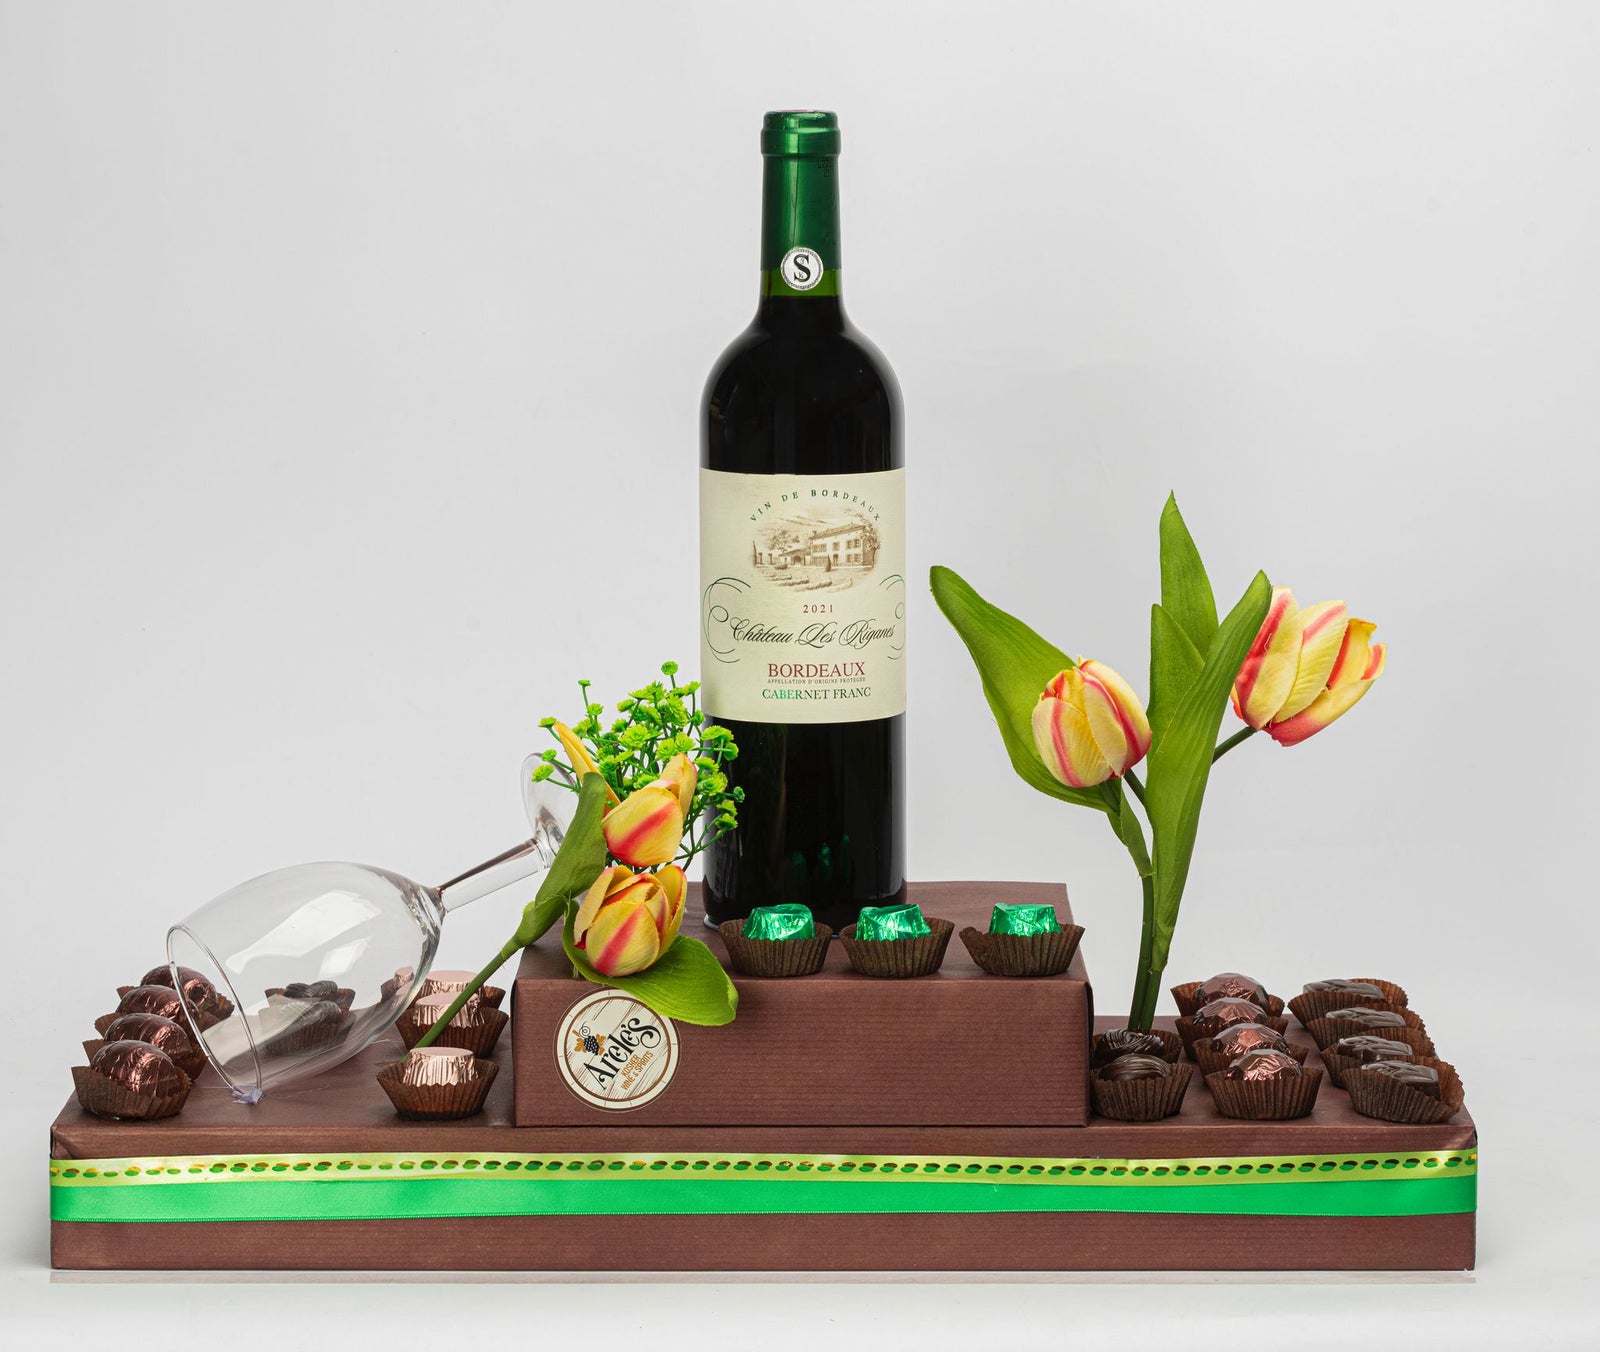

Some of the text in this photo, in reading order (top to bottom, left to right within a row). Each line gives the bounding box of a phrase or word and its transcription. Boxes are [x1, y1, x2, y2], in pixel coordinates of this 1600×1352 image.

[793, 253, 811, 282] S
[750, 489, 880, 521] VIN DE BORDEAUX
[802, 604, 834, 613] 2021
[730, 617, 895, 649] Château Les Riganes
[767, 661, 865, 678] BORDEAUX
[762, 687, 871, 699] CABERNET FRANC
[620, 1075, 635, 1090] WINE
[635, 1050, 653, 1072] SPIRITS
[621, 1054, 640, 1077] KOSHER
